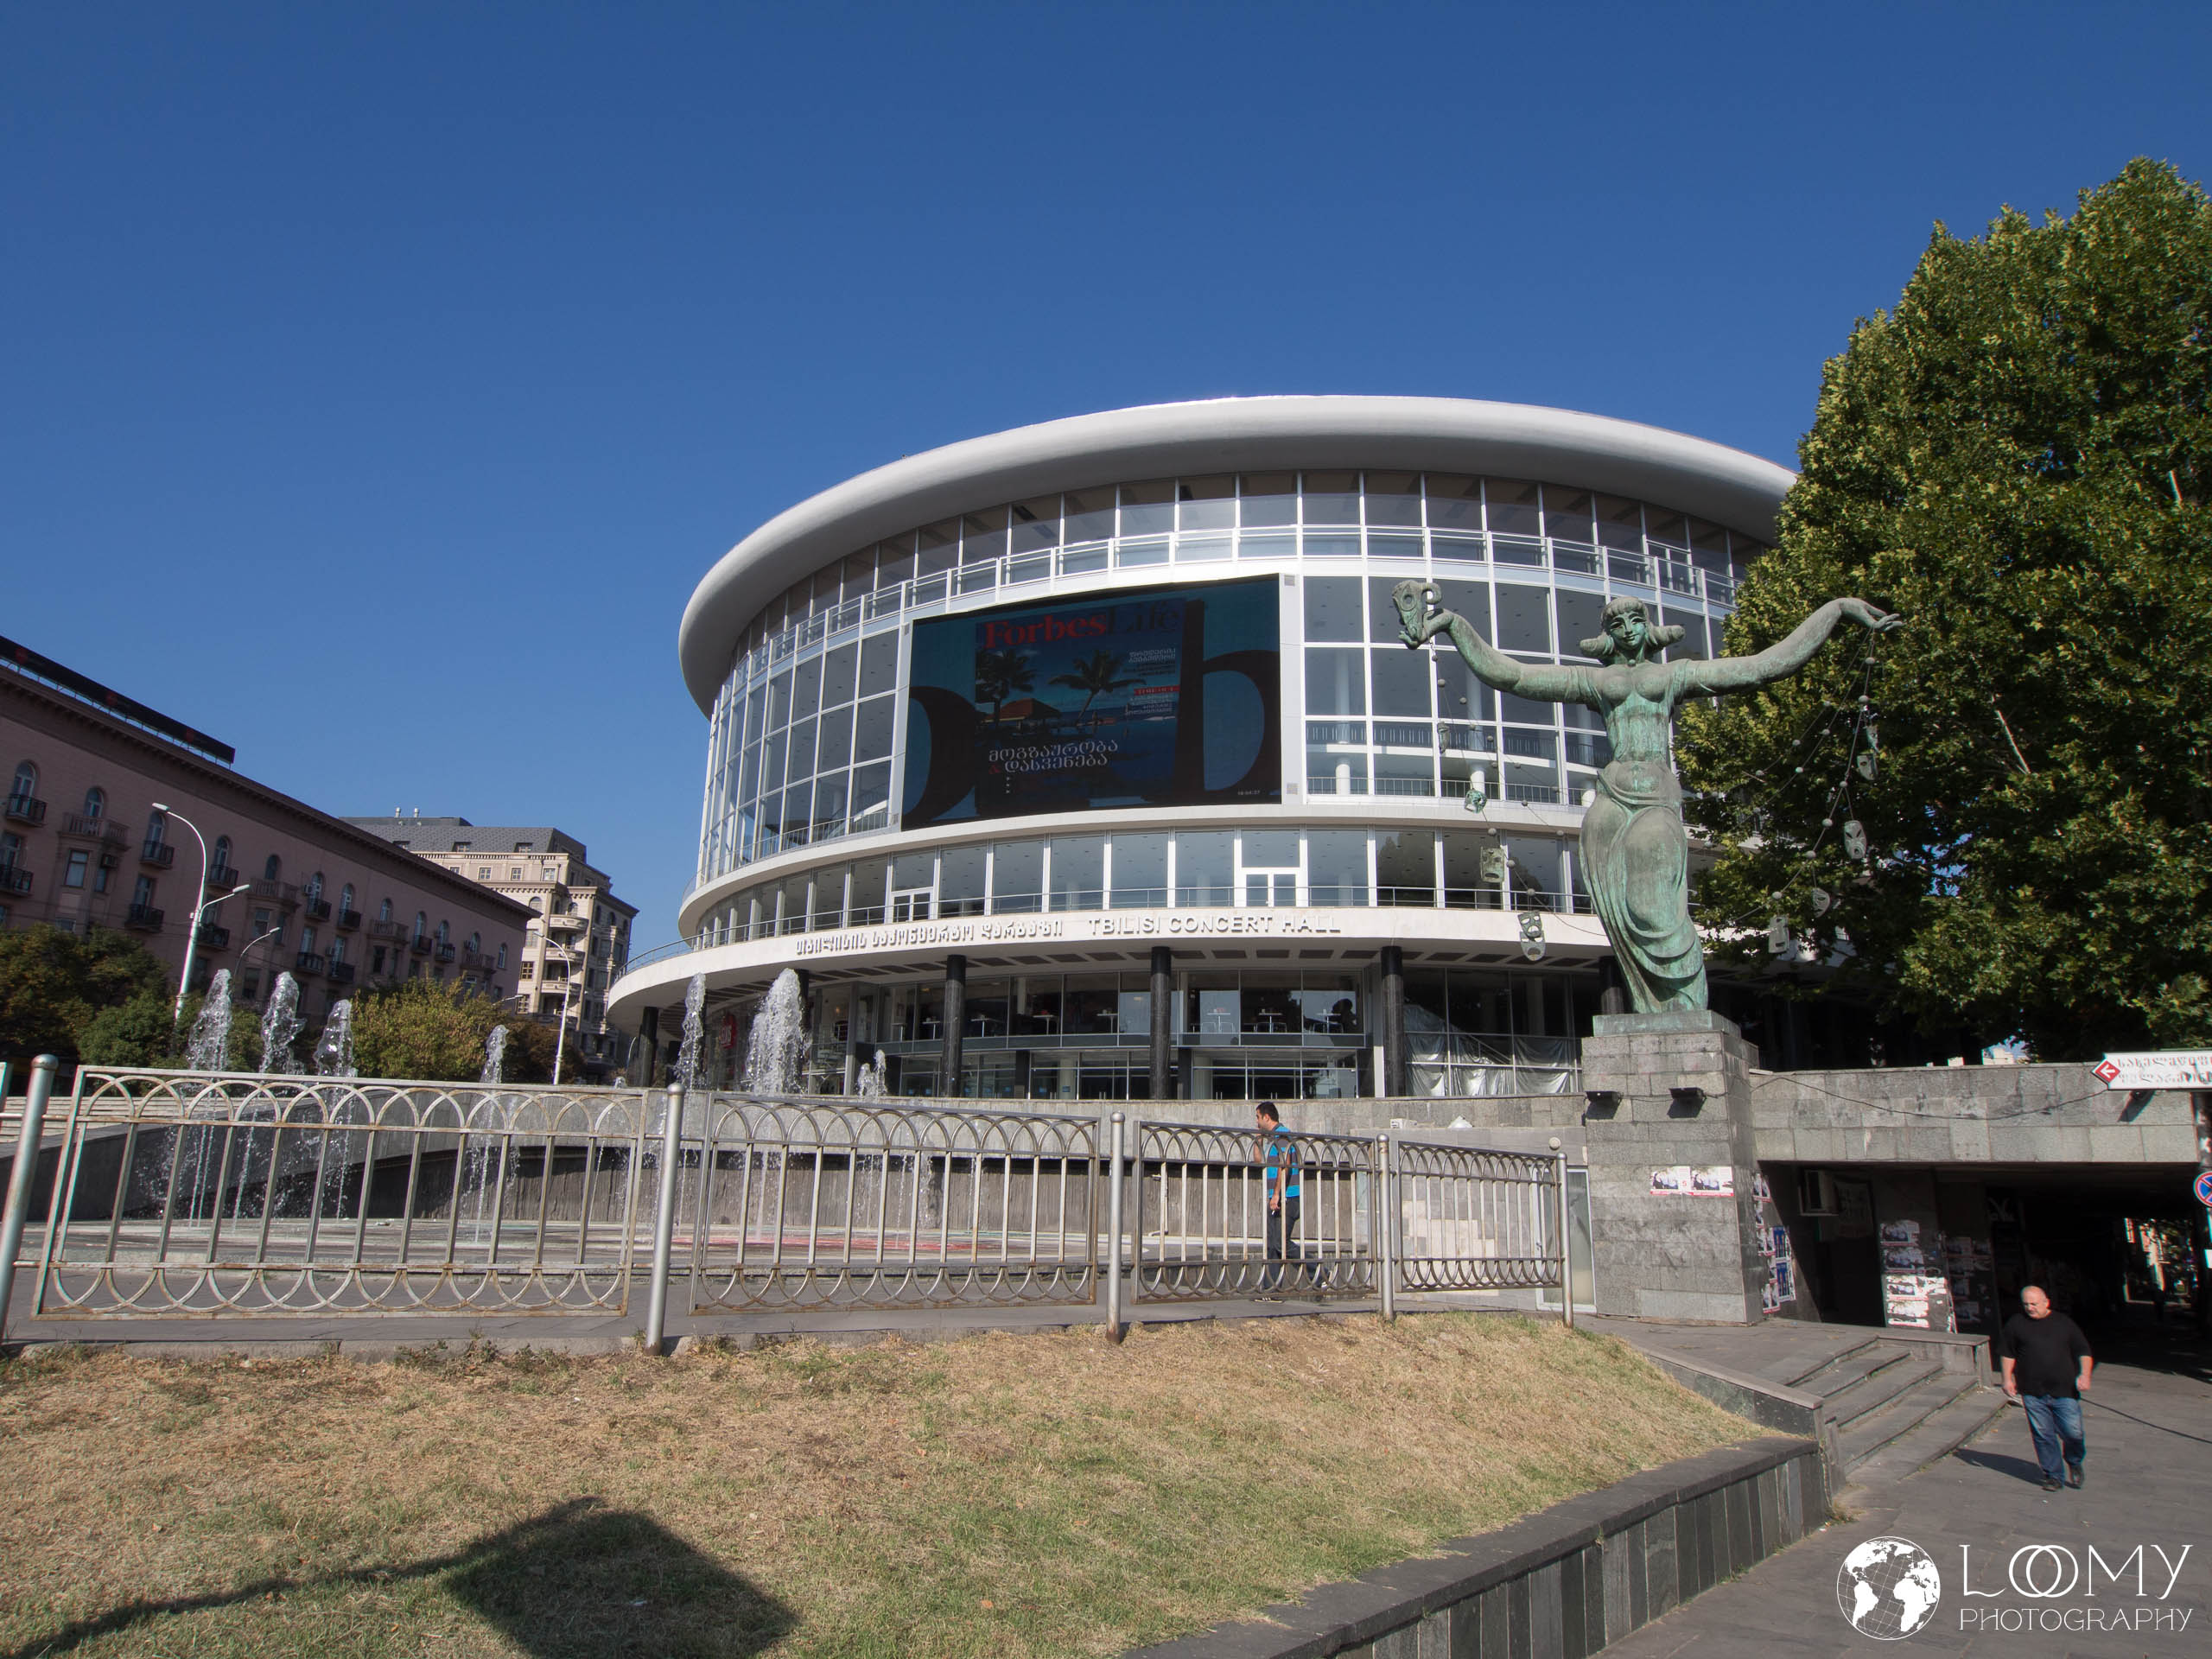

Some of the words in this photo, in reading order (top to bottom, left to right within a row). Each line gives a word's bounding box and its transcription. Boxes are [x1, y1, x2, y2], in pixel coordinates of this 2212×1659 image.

[988, 739, 1119, 762] მოგზაურობა
[1004, 753, 1109, 773] დასვენება
[1089, 916, 1160, 936] TBILISI
[1168, 915, 1273, 934] CONCERT
[1282, 914, 1341, 933] HALL
